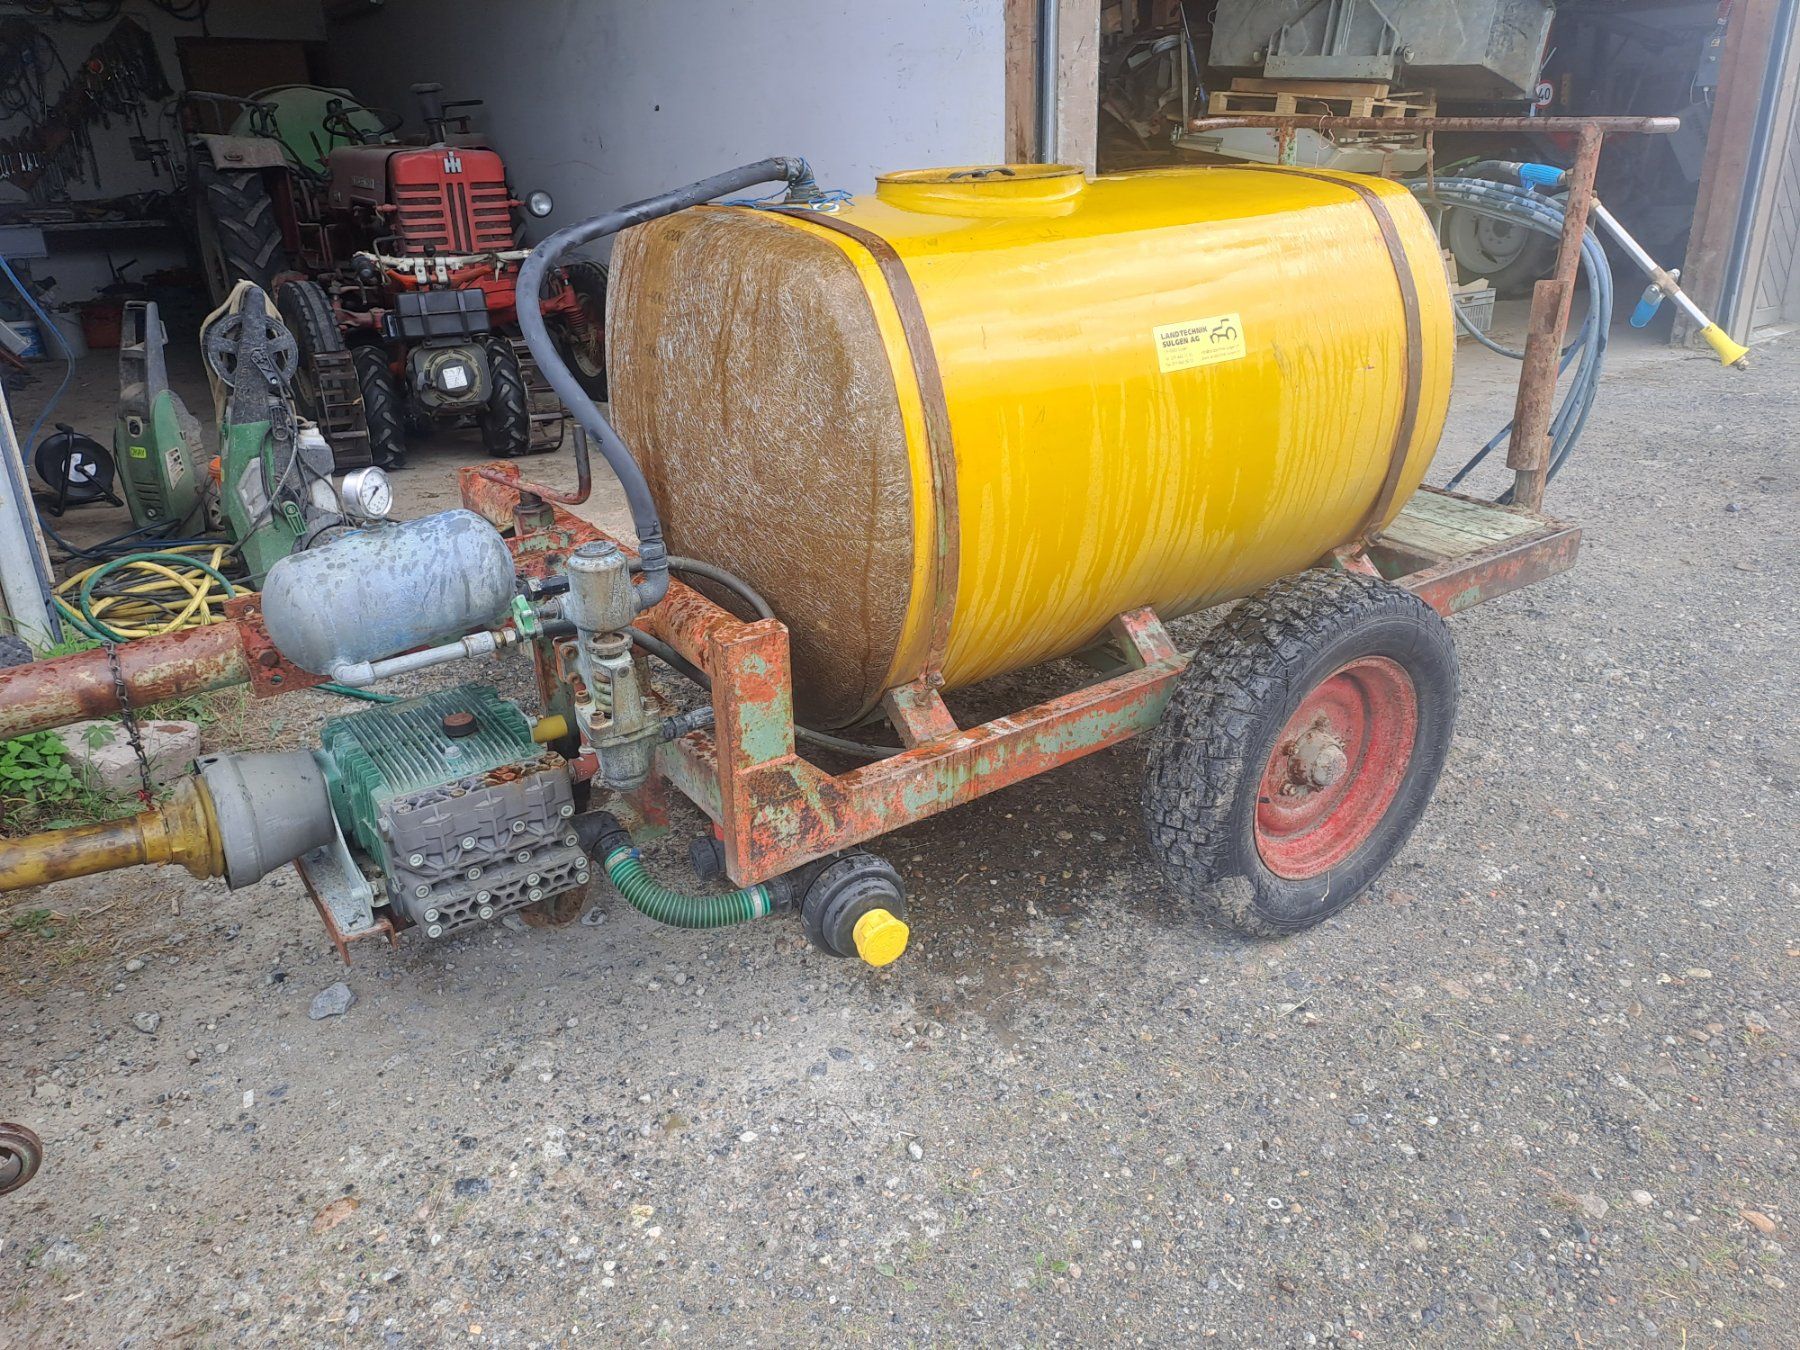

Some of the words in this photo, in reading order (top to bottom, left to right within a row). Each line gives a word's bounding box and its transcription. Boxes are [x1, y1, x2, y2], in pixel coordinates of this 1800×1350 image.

[1538, 87, 1550, 100] 40
[1160, 326, 1208, 340] LANDTECHNIK
[1162, 337, 1189, 348] SULGEN
[1190, 335, 1201, 343] AG
